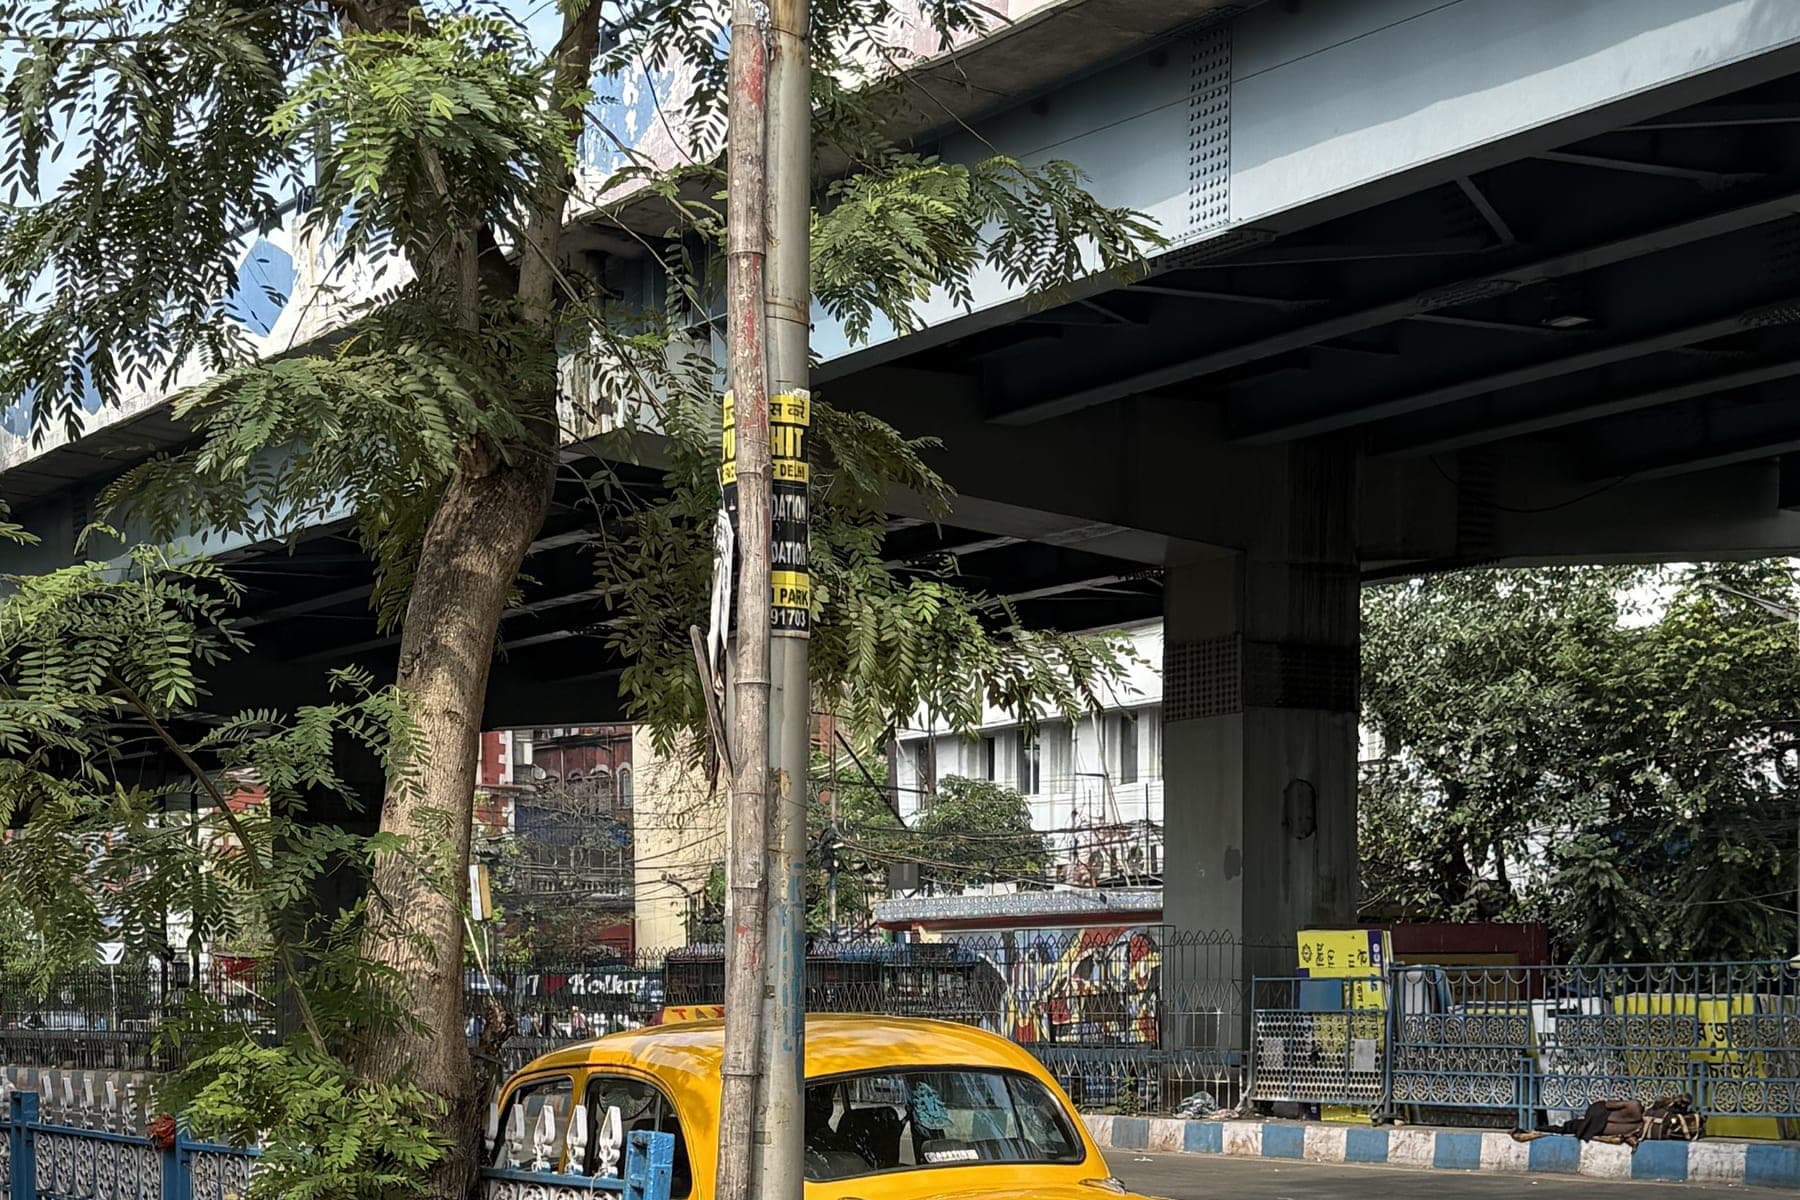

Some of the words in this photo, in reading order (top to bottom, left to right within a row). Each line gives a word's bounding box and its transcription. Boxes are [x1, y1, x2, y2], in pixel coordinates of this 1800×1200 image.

[780, 462, 805, 480] DELHI
[771, 494, 806, 522] DATION
[771, 541, 806, 566] DATION
[780, 587, 808, 606] PARK
[771, 609, 806, 627] 91703
